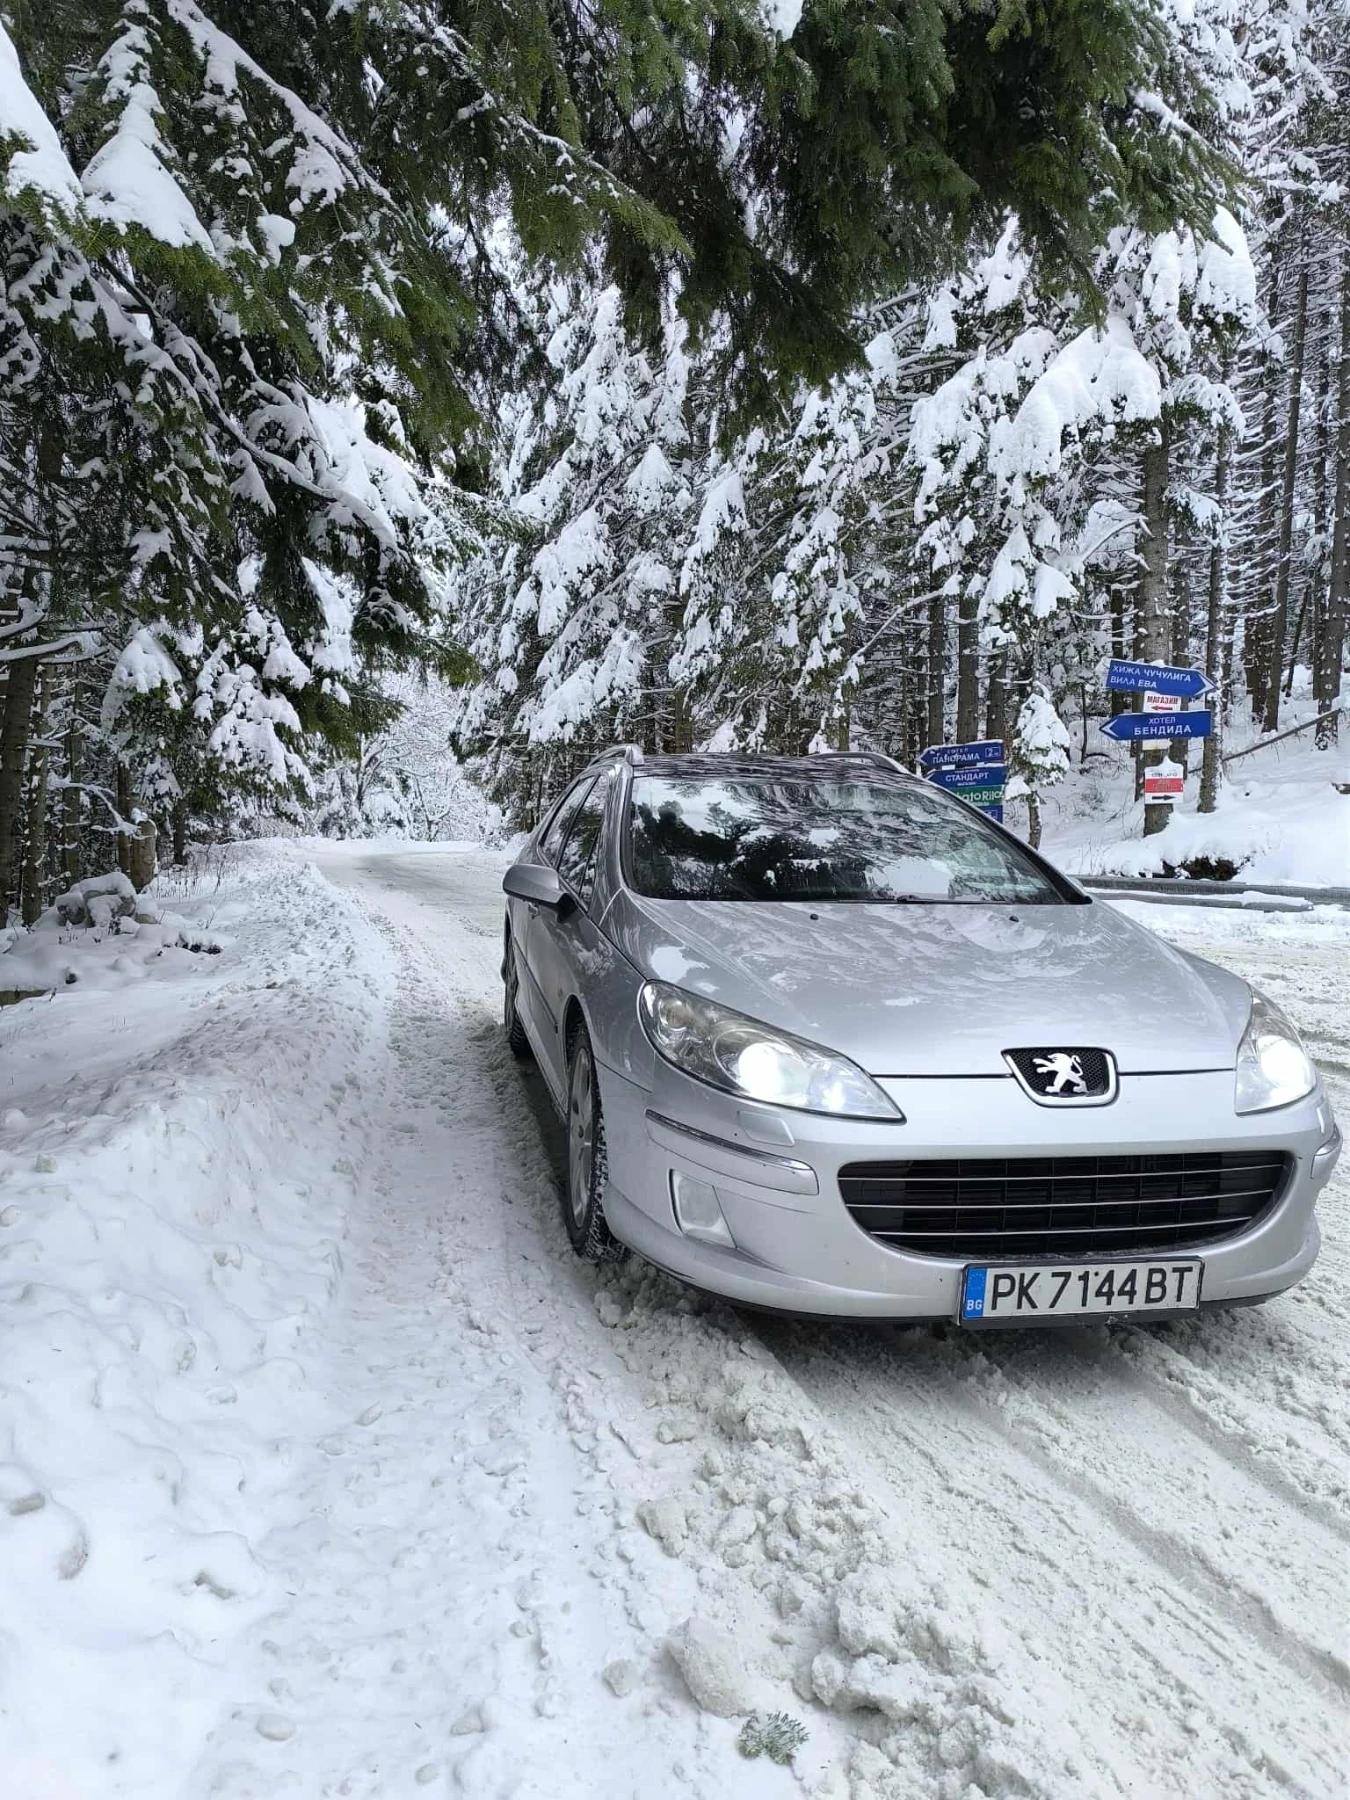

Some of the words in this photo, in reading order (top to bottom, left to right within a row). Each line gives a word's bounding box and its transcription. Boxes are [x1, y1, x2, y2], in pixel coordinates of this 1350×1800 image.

[1112, 665, 1140, 676] ХИЖА
[1143, 669, 1192, 683] ЧУЧУЛИГА
[1110, 676, 1136, 686] ВИЛА
[1137, 679, 1157, 689] ЕВА
[1147, 695, 1180, 705] МАГАЗИН
[1148, 716, 1176, 724] ХОТЕЛ
[1134, 726, 1192, 736] БЕНДИДА
[932, 752, 981, 764] ПАНОРАМА
[945, 772, 989, 782] СТАНДАРТ
[966, 1299, 983, 1311] BG
